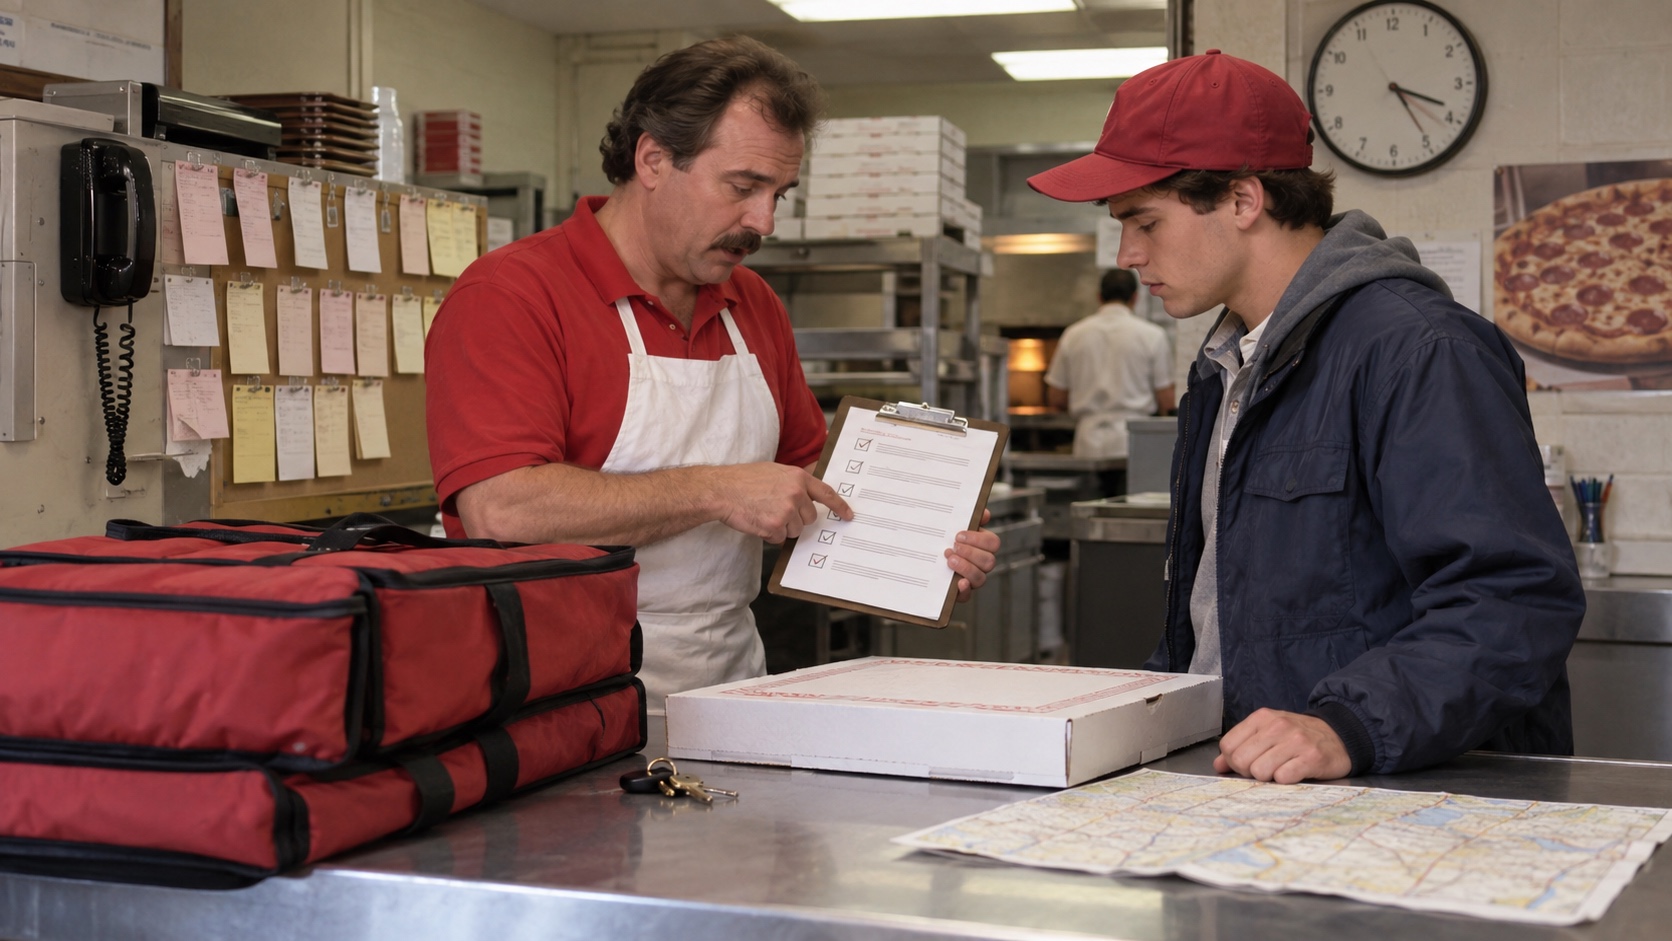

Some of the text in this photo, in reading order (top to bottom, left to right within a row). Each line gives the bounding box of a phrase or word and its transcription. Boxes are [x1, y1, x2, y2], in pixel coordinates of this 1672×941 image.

[1386, 17, 1399, 31] 12
[1423, 24, 1428, 37] 1
[1357, 28, 1367, 41] 11
[1334, 51, 1346, 64] 10
[1445, 45, 1454, 58] 2
[1454, 77, 1463, 90] 3
[1325, 84, 1334, 97] 9
[1334, 116, 1343, 129] 8
[1445, 111, 1454, 124] 4
[1359, 137, 1368, 150] 7
[1422, 135, 1431, 149] 5
[1389, 144, 1398, 158] 6
